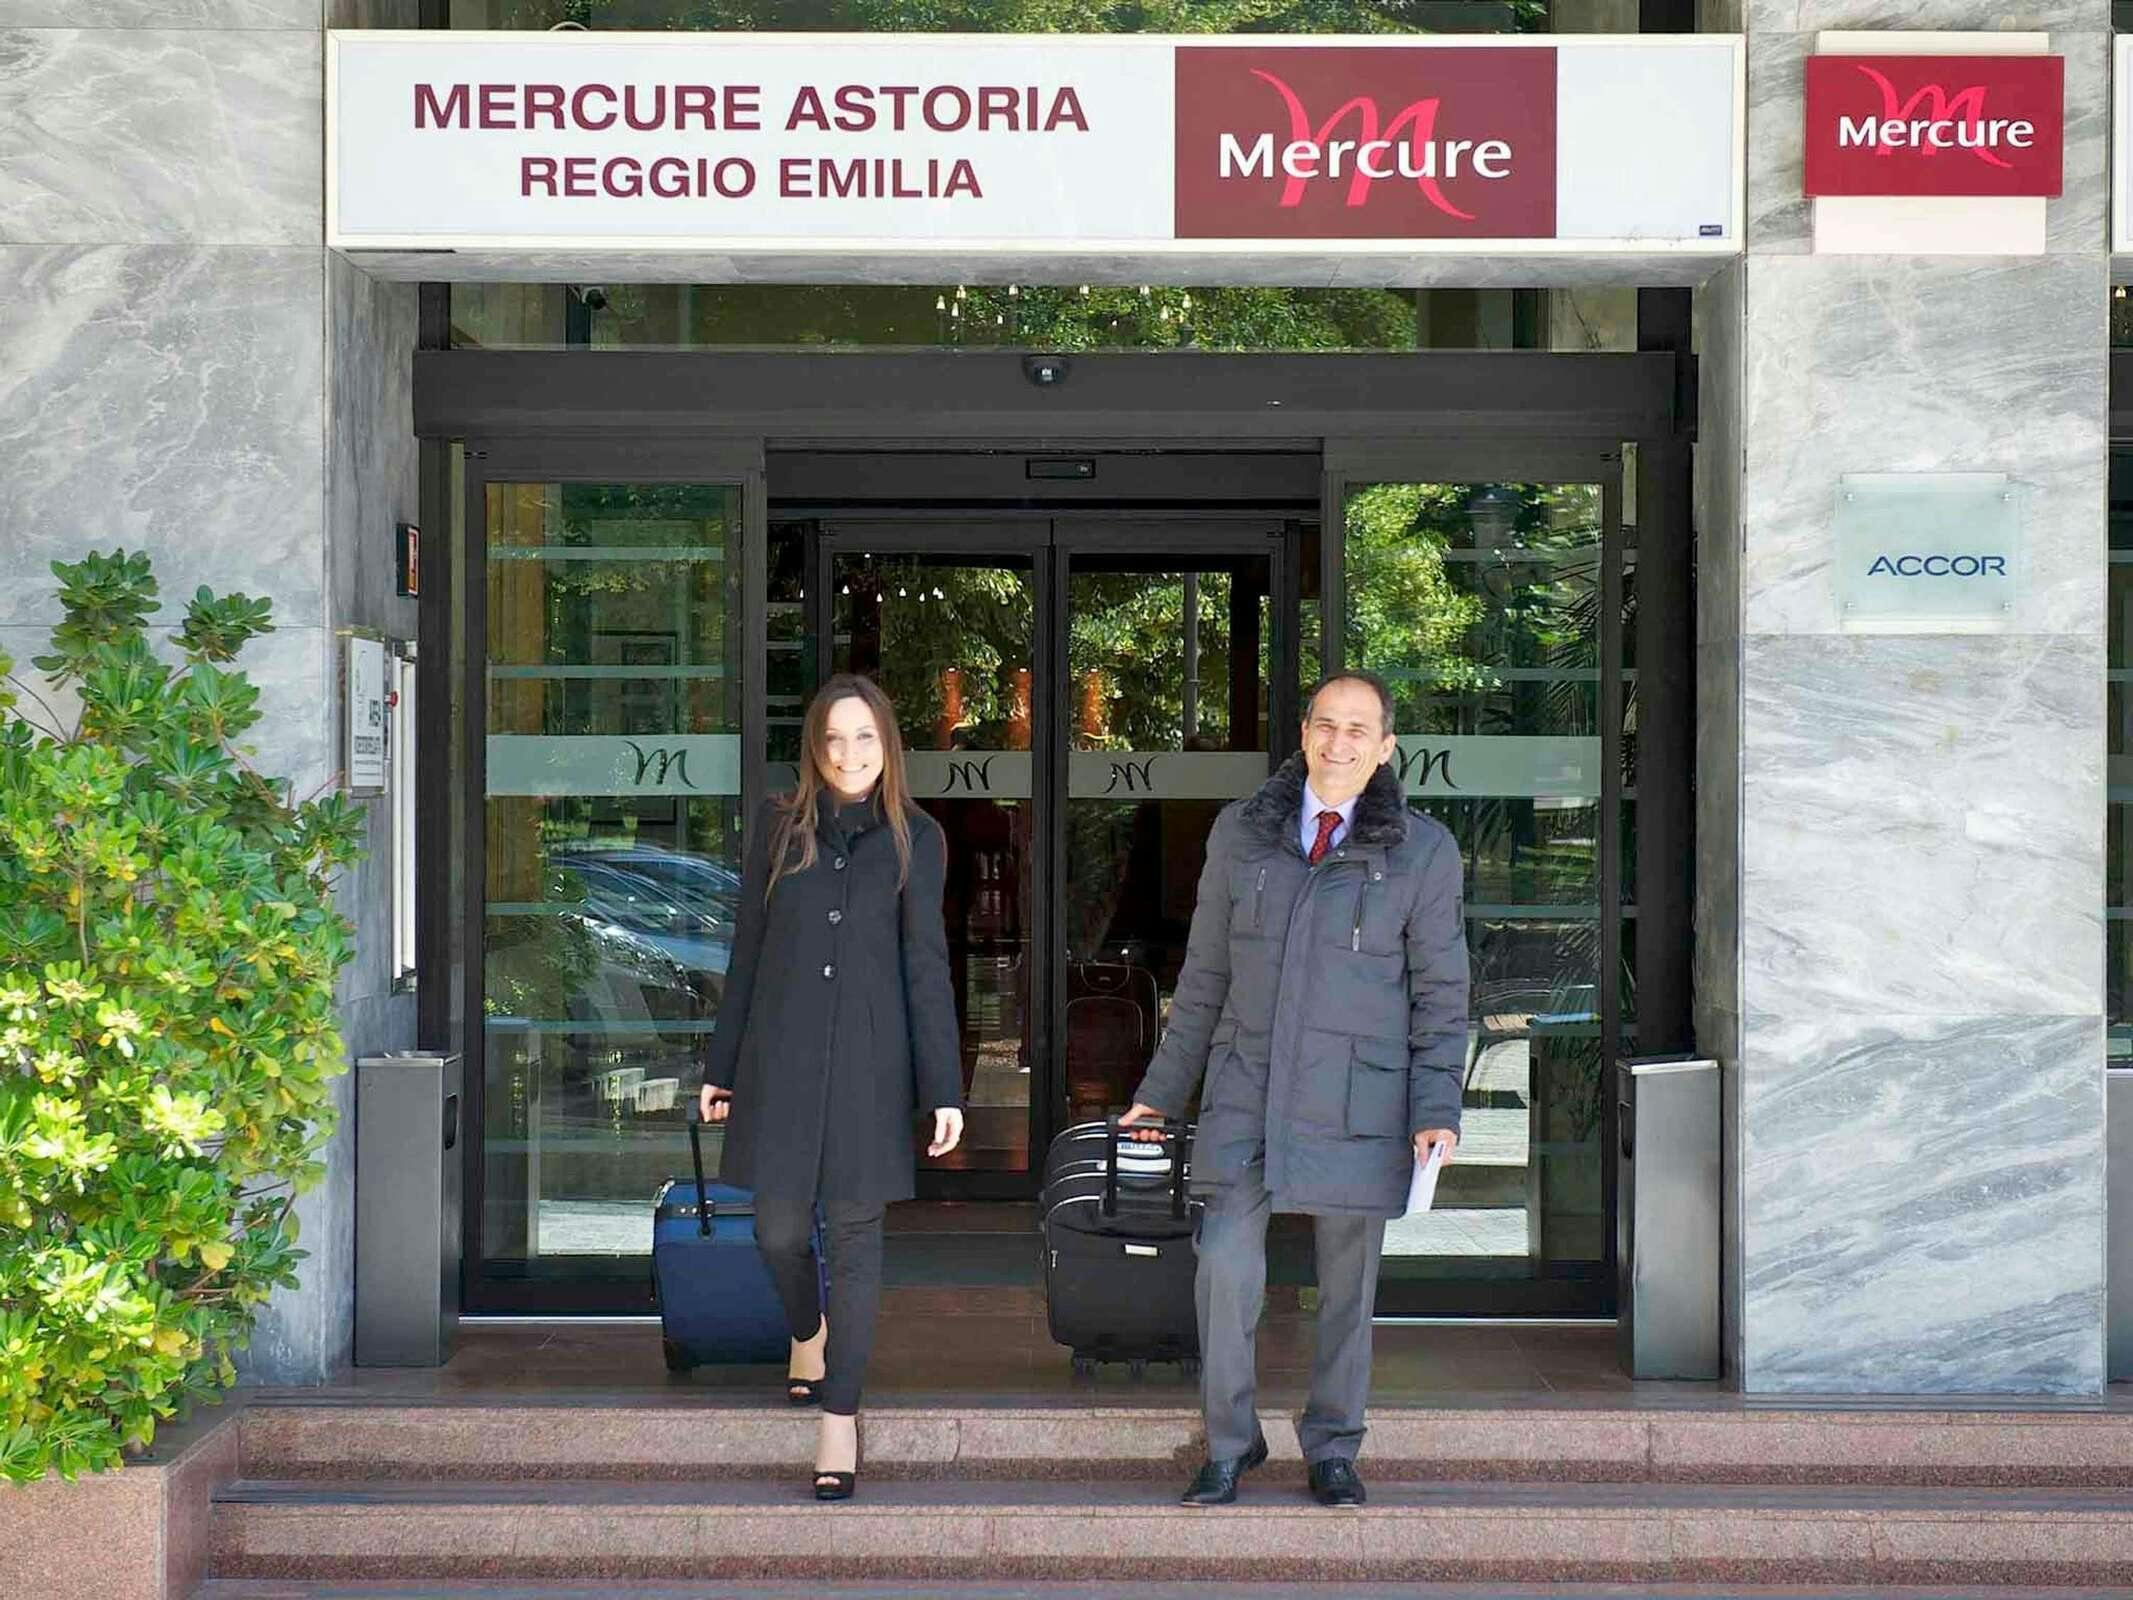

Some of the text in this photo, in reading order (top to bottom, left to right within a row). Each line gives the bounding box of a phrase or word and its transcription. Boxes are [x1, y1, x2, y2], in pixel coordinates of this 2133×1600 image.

[414, 83, 1089, 132] MERCURE ASTORIA
[1838, 115, 2035, 148] Mercure
[1219, 132, 1512, 179] Mercure
[521, 156, 983, 199] REGGIO EMILIA
[1867, 555, 2006, 577] ACCOR
